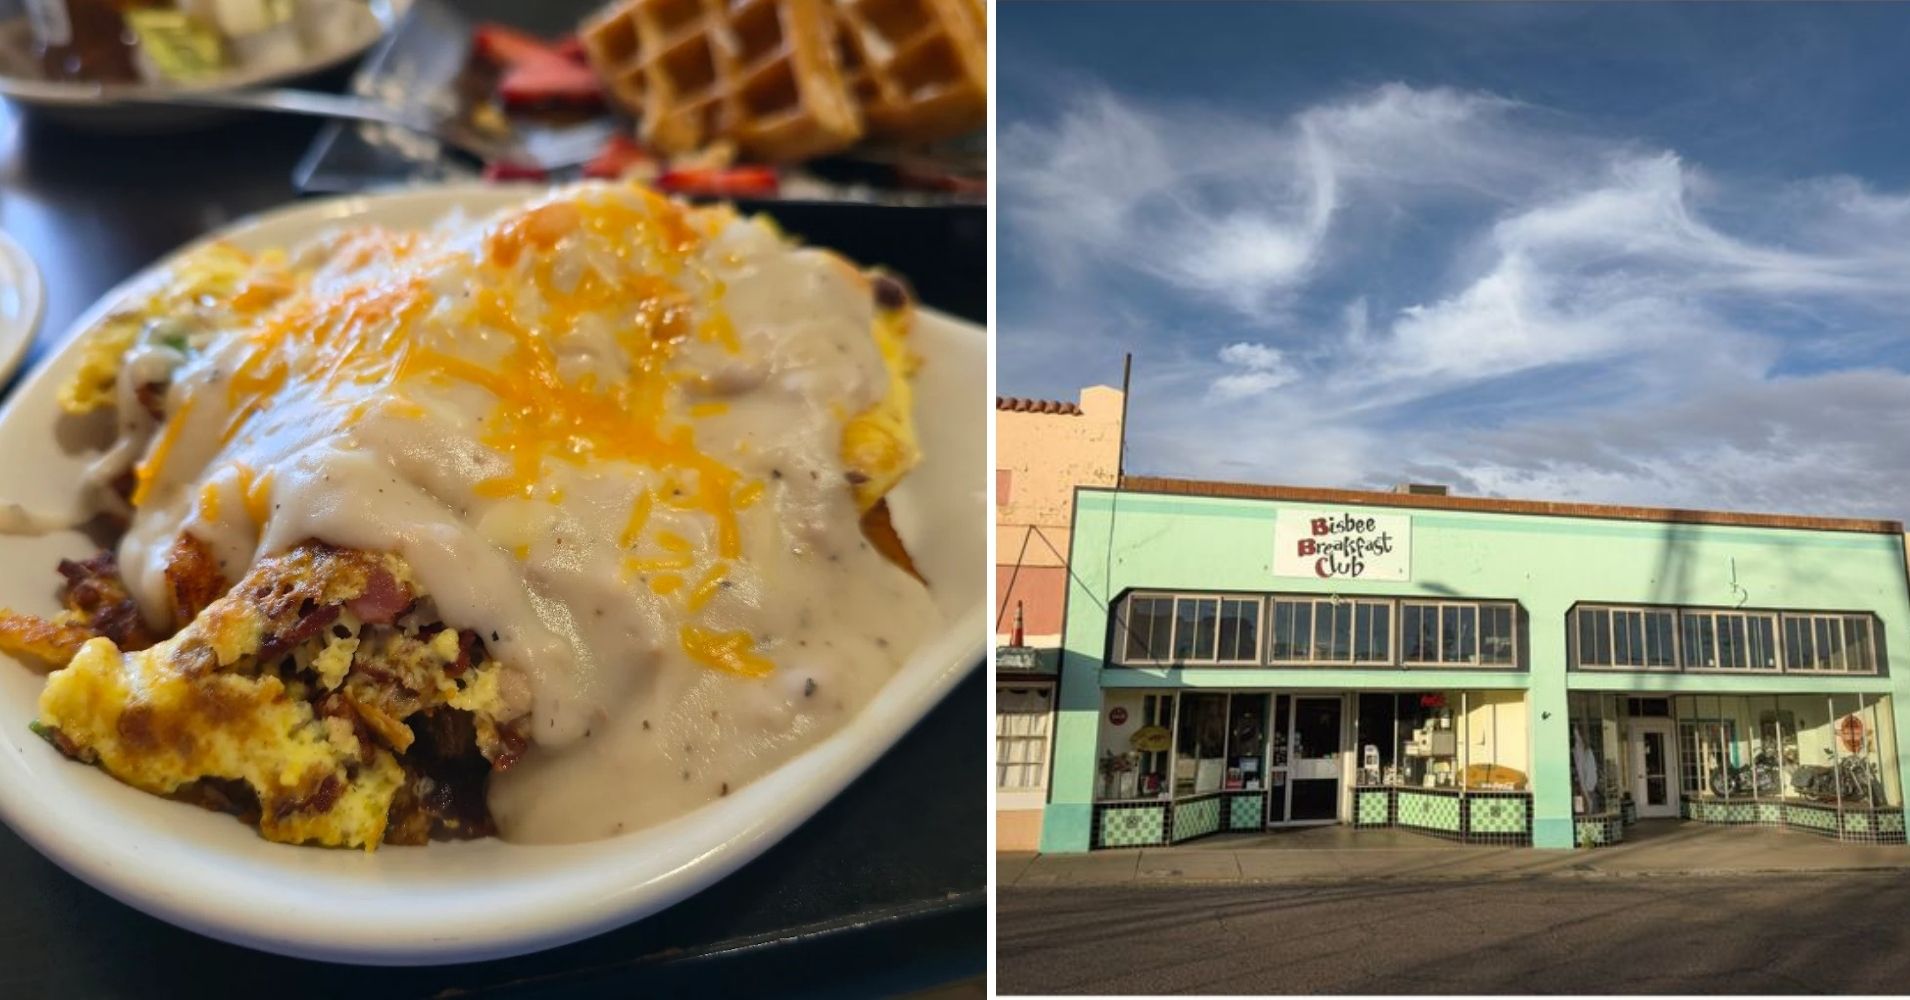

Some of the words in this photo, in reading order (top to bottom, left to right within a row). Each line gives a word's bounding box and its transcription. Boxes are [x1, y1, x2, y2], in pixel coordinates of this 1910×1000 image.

[1310, 513, 1376, 536] Bisbee
[1297, 532, 1393, 557] Breakfast
[1315, 553, 1365, 578] Club
